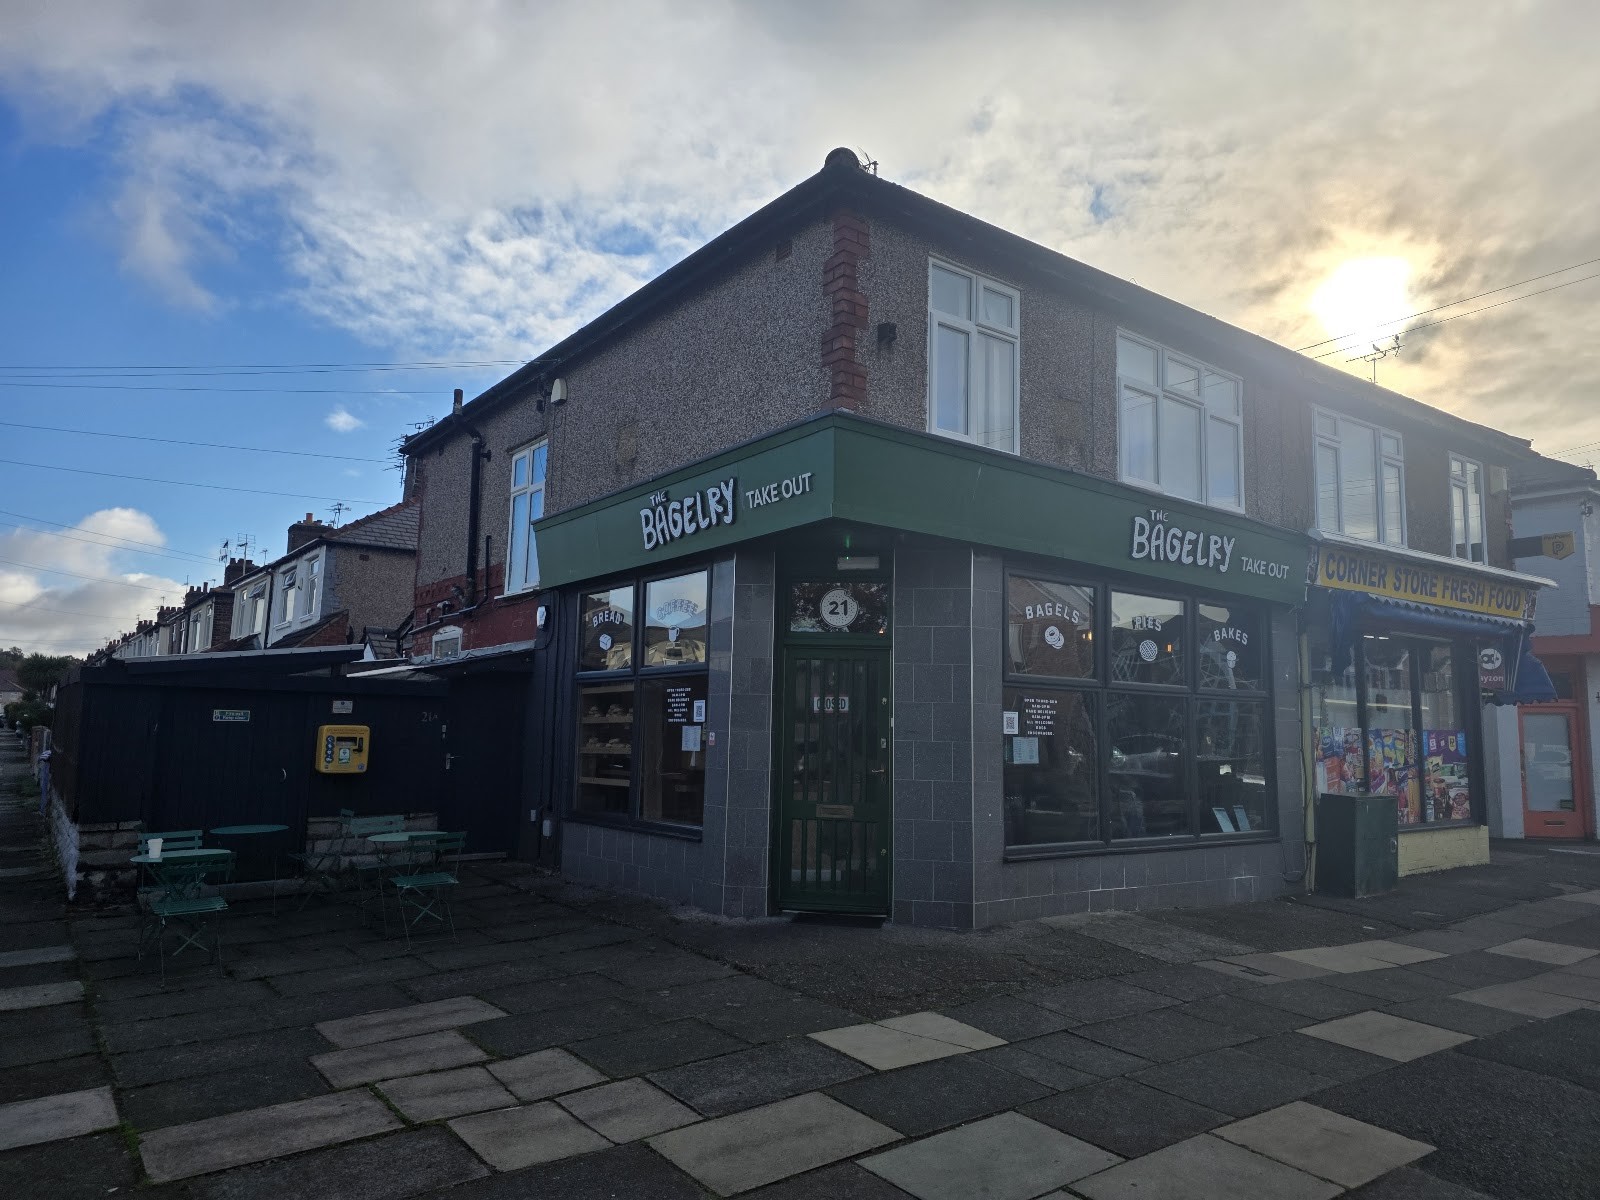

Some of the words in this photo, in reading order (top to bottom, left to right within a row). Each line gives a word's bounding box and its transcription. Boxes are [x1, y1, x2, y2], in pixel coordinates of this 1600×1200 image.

[650, 490, 667, 506] THE
[746, 482, 779, 508] TAKE
[781, 472, 811, 498] OUT
[640, 478, 734, 550] BAGELRY
[1150, 510, 1168, 522] THE
[1132, 516, 1235, 573] BAGELRY
[1241, 556, 1266, 575] TAKE
[1268, 562, 1289, 579] OUT
[1326, 553, 1387, 589] CORNER
[1393, 569, 1438, 598] STORE
[1442, 575, 1485, 606] FRESH
[1488, 585, 1521, 611] FOOD
[829, 600, 848, 616] 21
[1025, 603, 1079, 624] BAGELS
[593, 611, 620, 627] BREAD
[1134, 615, 1162, 631] PIES
[1214, 627, 1248, 645] BAKES
